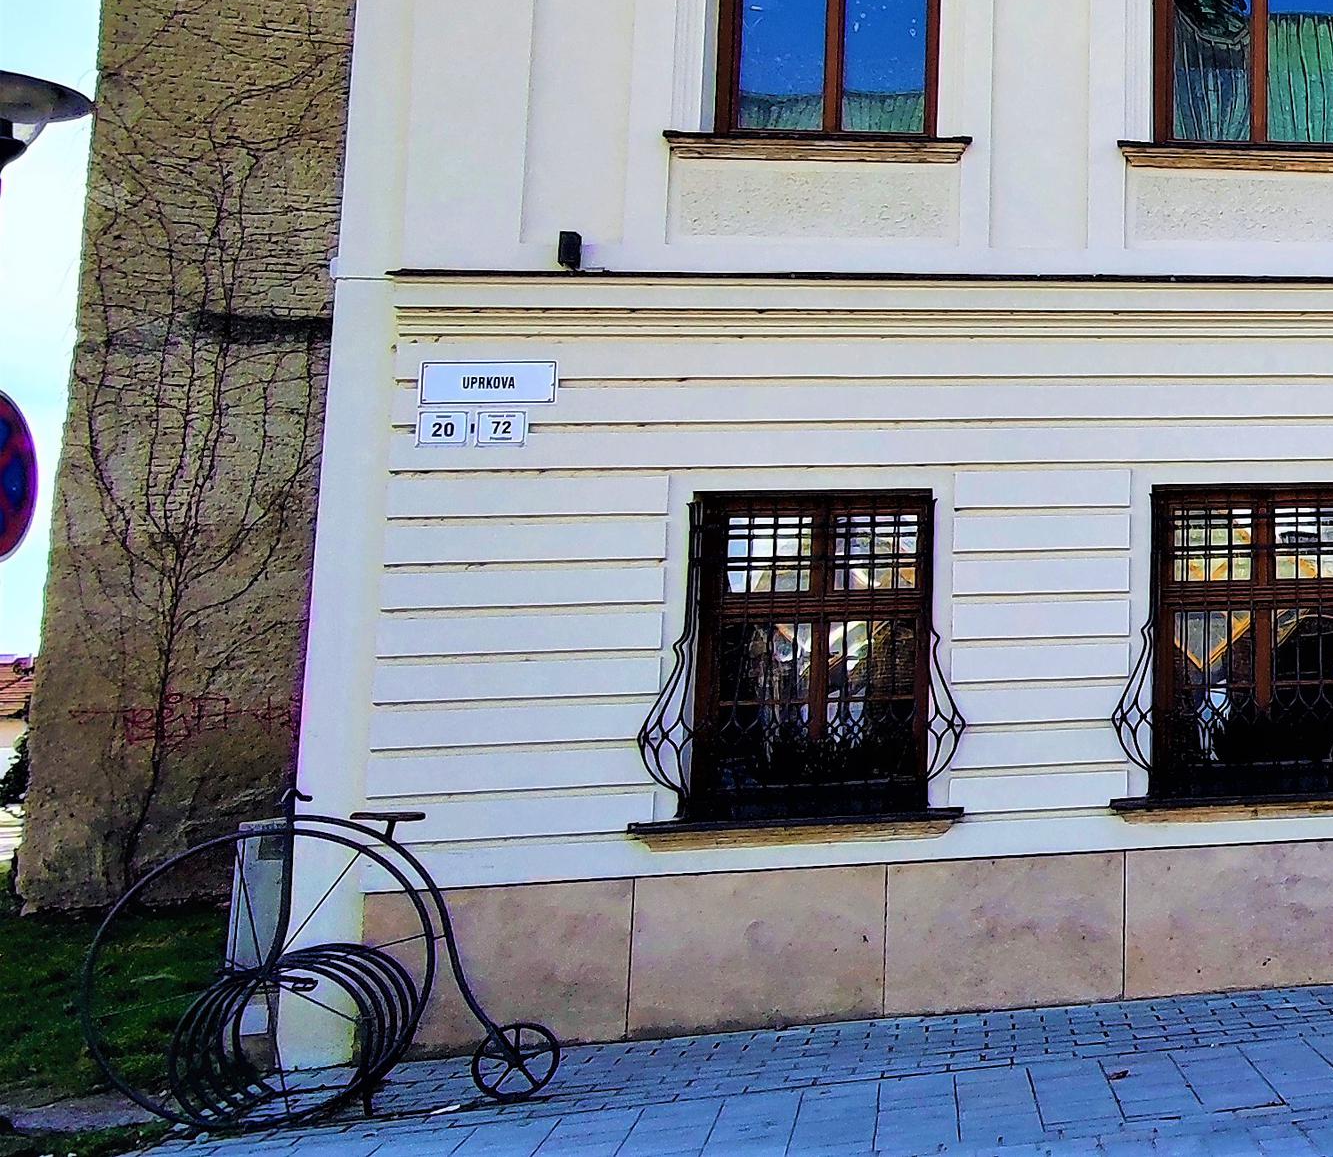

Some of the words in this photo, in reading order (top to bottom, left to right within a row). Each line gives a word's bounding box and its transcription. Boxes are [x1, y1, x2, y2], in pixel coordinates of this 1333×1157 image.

[462, 376, 516, 390] UPRKOVA
[431, 422, 455, 438] 20
[491, 420, 512, 435] 72
